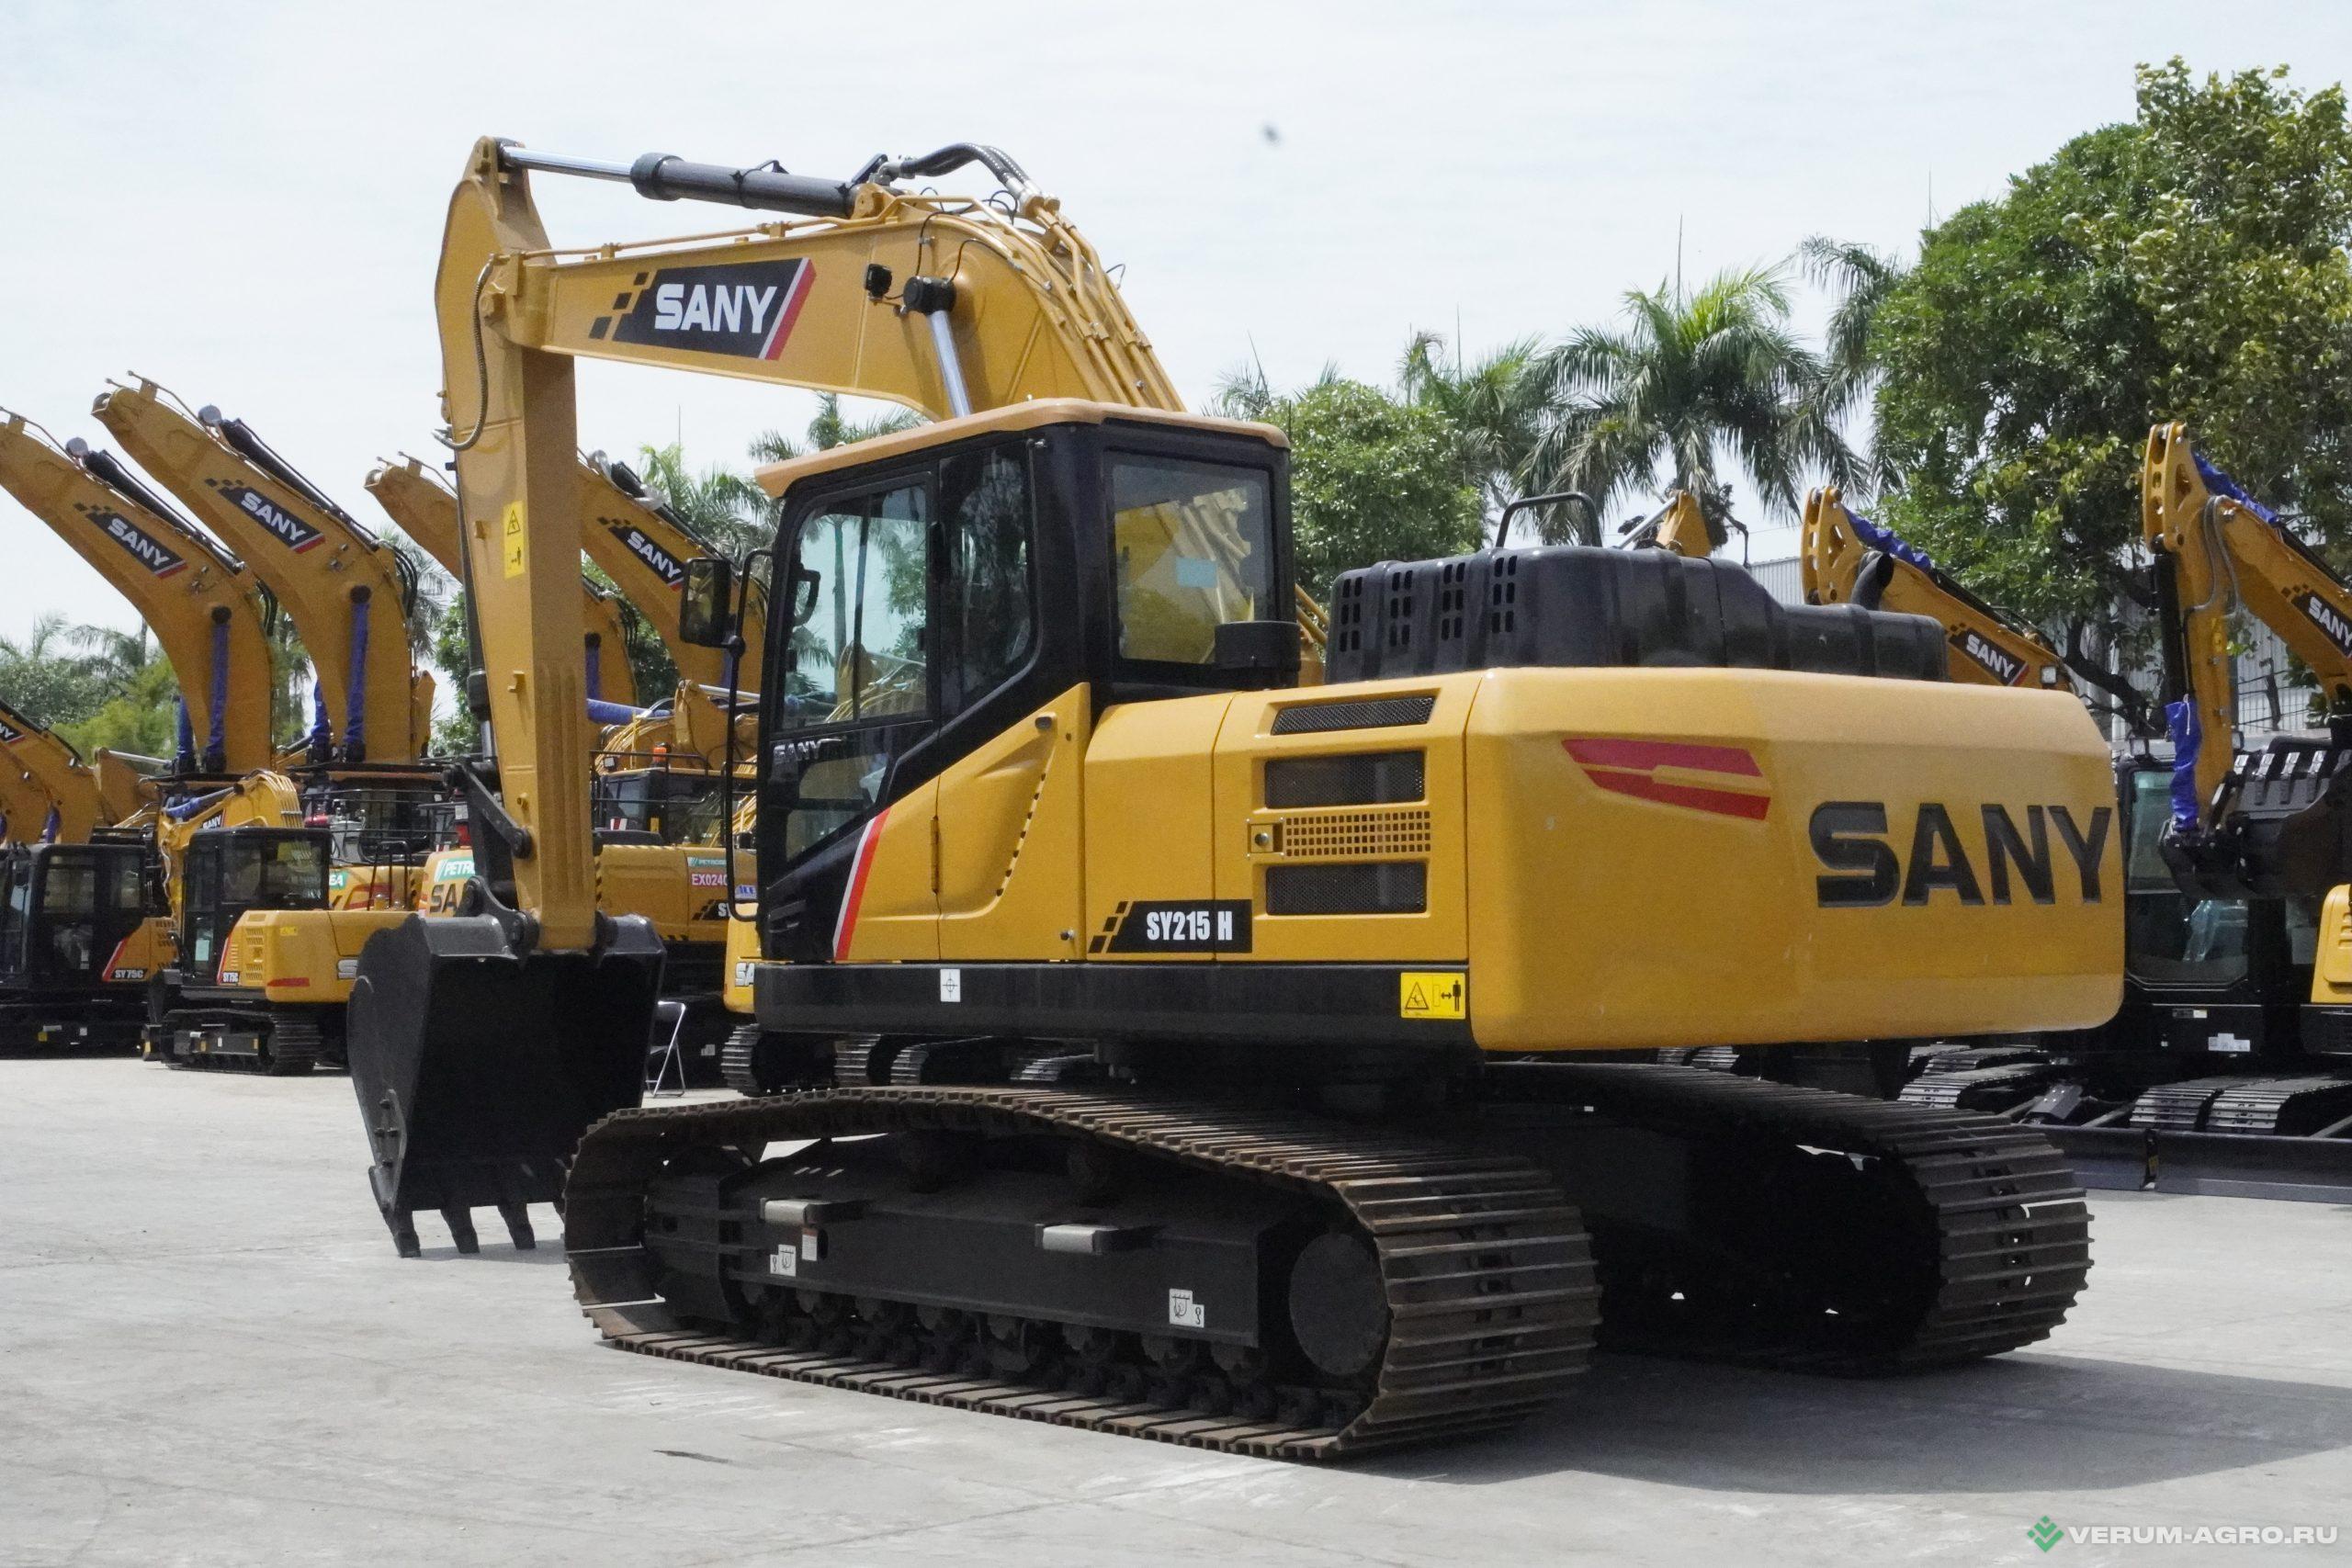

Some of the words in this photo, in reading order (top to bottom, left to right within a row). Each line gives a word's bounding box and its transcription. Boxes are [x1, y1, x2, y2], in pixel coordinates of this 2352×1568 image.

[654, 283, 777, 334] SANY
[241, 492, 307, 541] SANY
[107, 518, 169, 568] SANY
[627, 531, 682, 579] SANY
[2309, 596, 2352, 647] SANY
[1966, 634, 2015, 678] SANY
[1808, 801, 2112, 908] SANY
[1147, 910, 1211, 942] SY215
[1217, 910, 1233, 942] H
